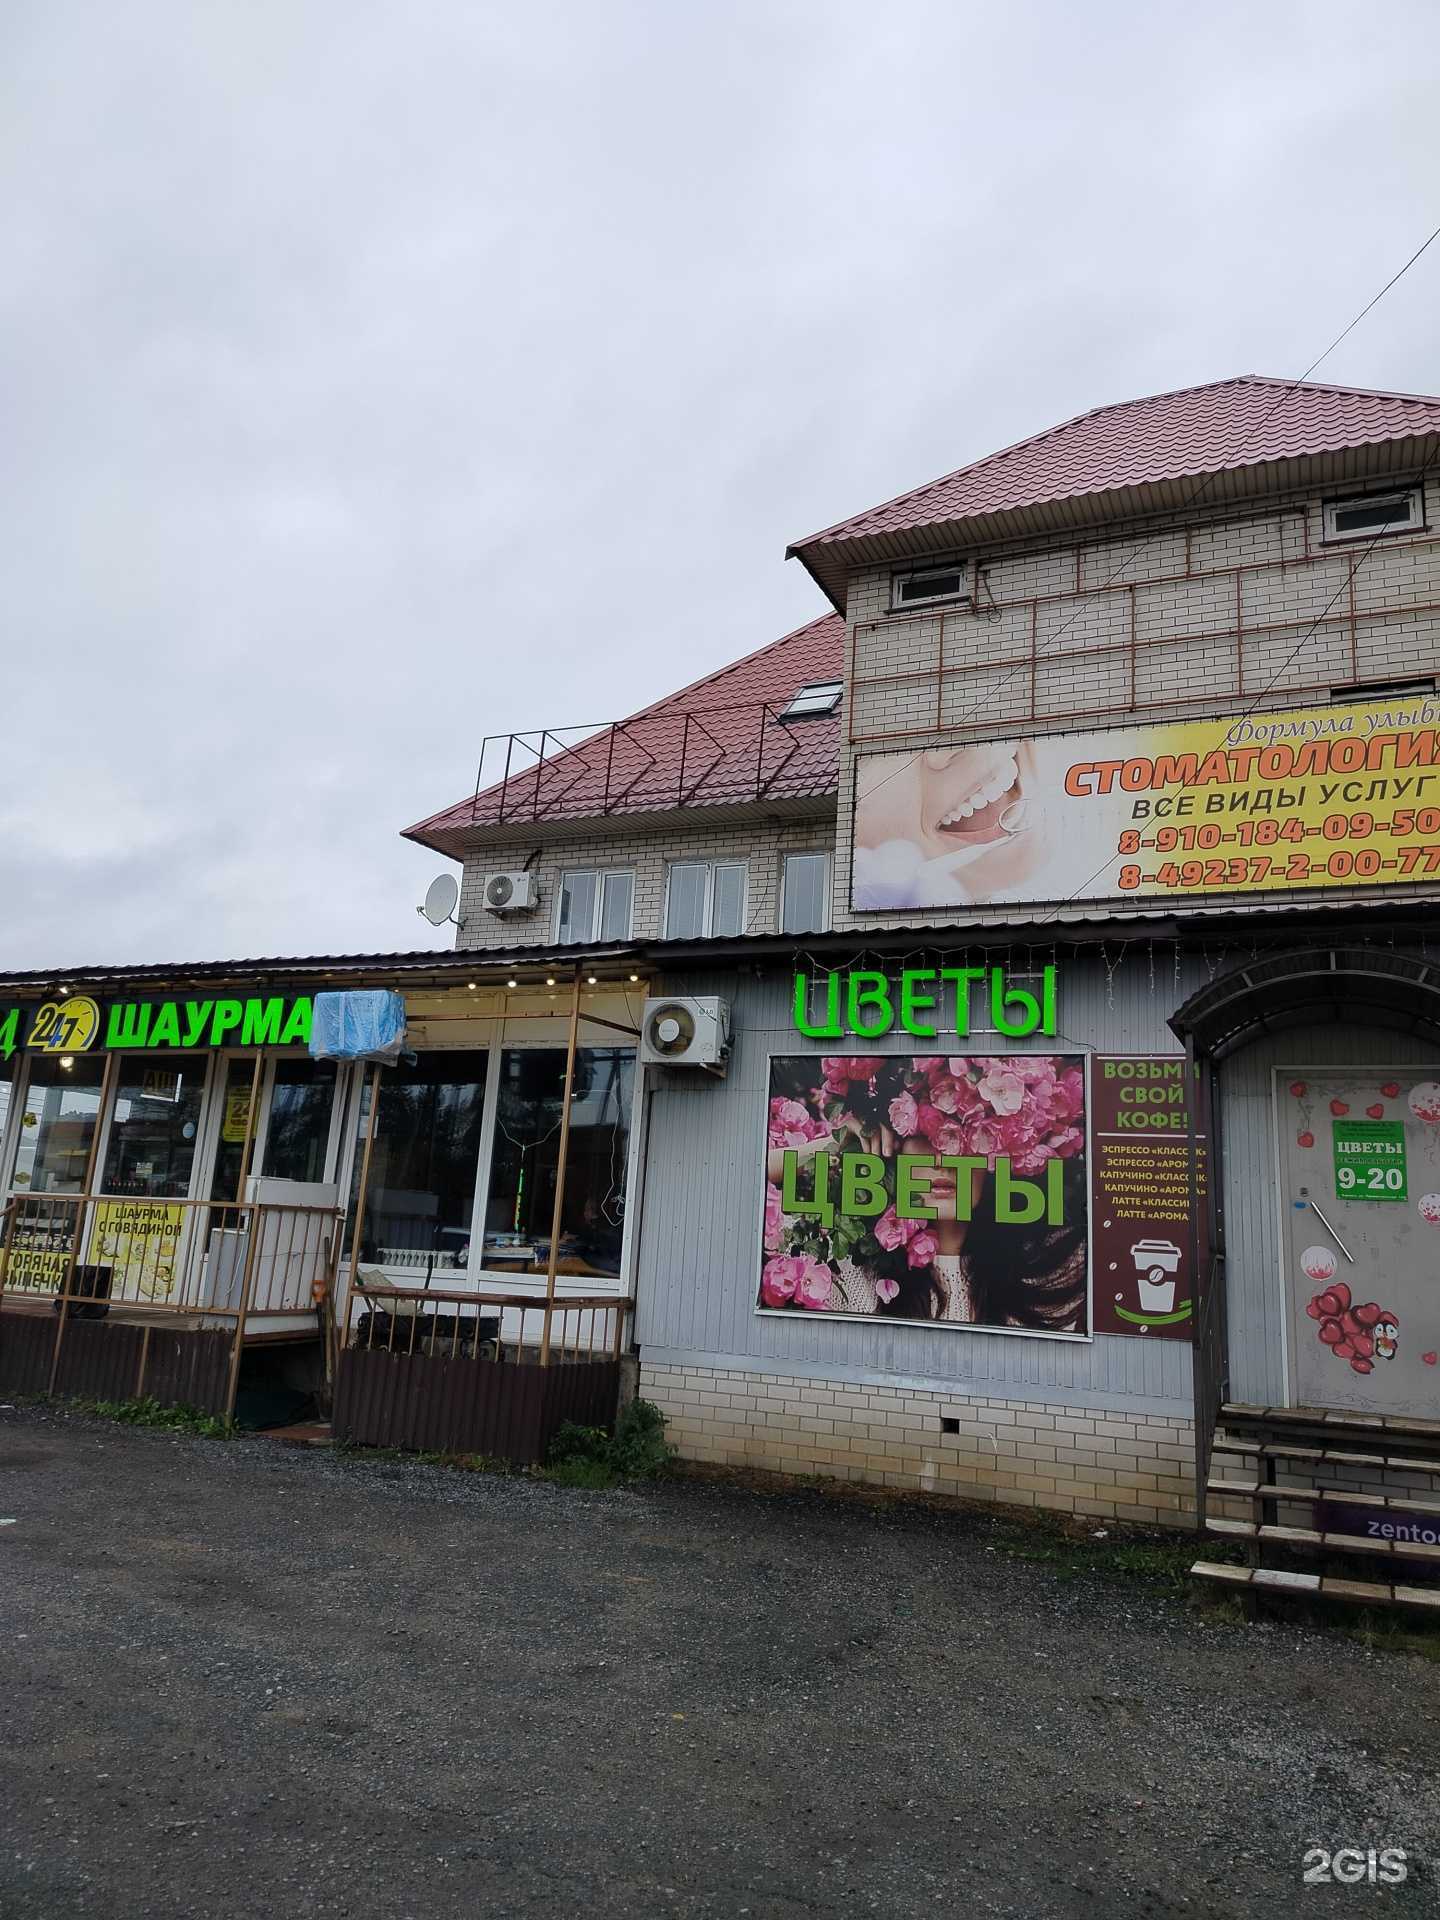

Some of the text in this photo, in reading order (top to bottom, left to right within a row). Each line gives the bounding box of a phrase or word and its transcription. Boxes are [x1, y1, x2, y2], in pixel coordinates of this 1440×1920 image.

[1132, 775, 1437, 819] ВСЕ ВИДЫ УСЛУГ
[1118, 806, 1440, 855] 8-910-184-09-50
[794, 966, 1057, 1038] ЦВЕТЫ
[105, 997, 313, 1047] ШАУРМА
[1120, 1083, 1184, 1104] СВОЙ
[1117, 1111, 1189, 1128] КОФЕ!
[1102, 1145, 1150, 1154] ЭСПРЕССО
[1337, 1141, 1403, 1154] ЦВЕТЫ
[1106, 1158, 1155, 1167] ЭСПРЕССО
[1100, 1171, 1153, 1180] КАПУЧИНО
[1338, 1167, 1403, 1190] 9-20
[781, 1150, 1065, 1229] ЦВЕТЫ
[1104, 1183, 1158, 1193] КАПУЧИНО
[1112, 1197, 1141, 1205] ЛАТТЕ
[1117, 1209, 1146, 1218] ЛАТТЕ
